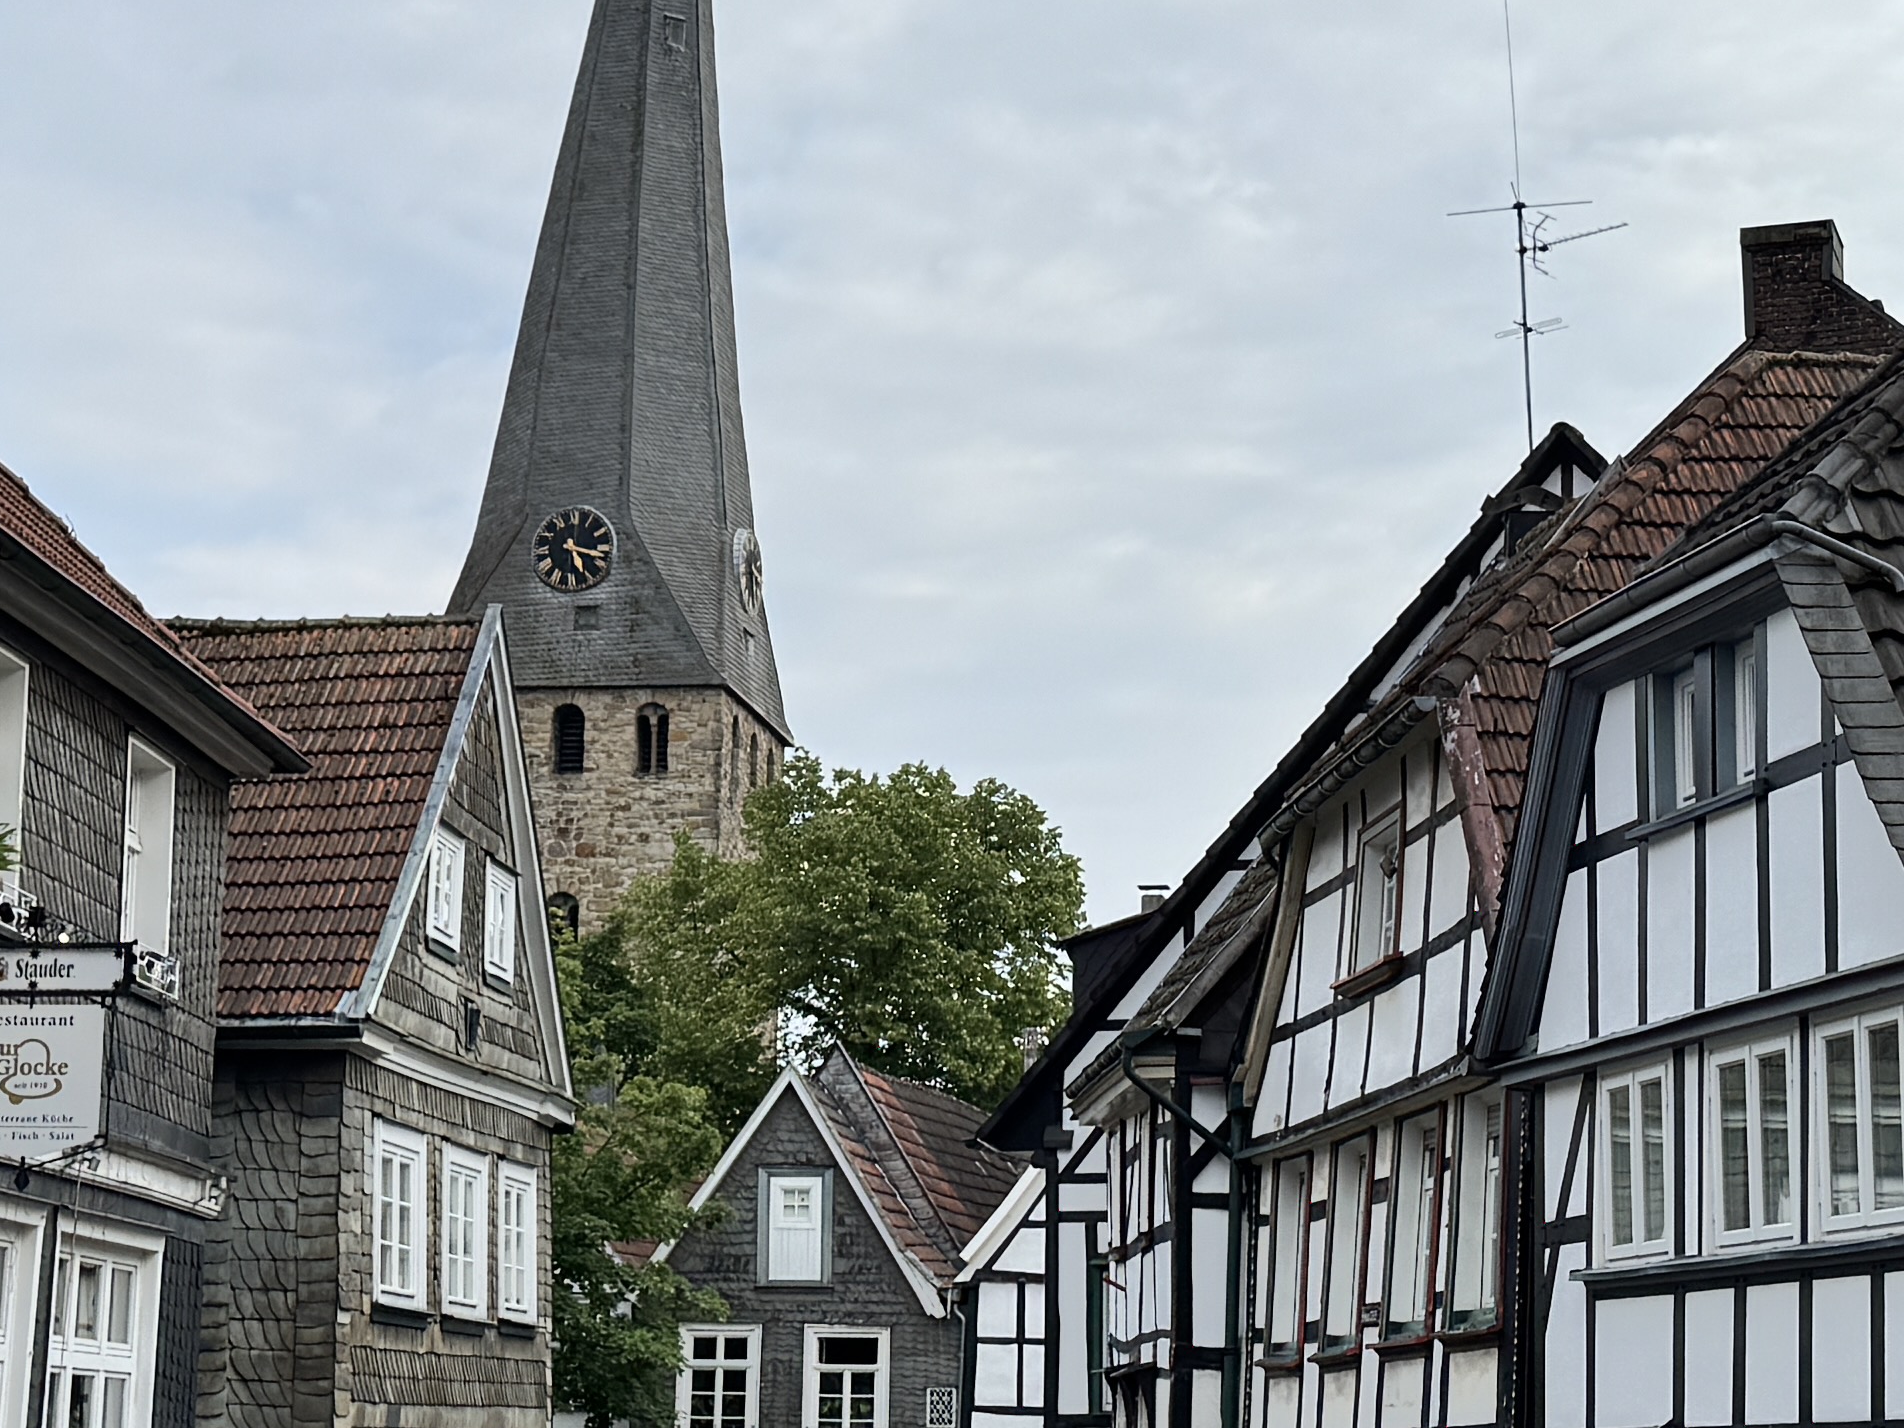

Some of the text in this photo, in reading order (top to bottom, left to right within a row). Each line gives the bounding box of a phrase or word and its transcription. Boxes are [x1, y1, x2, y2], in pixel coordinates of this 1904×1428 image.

[15, 957, 75, 981] Stauder
[11, 1132, 39, 1141] Fisch
[49, 1132, 75, 1141] Salat
